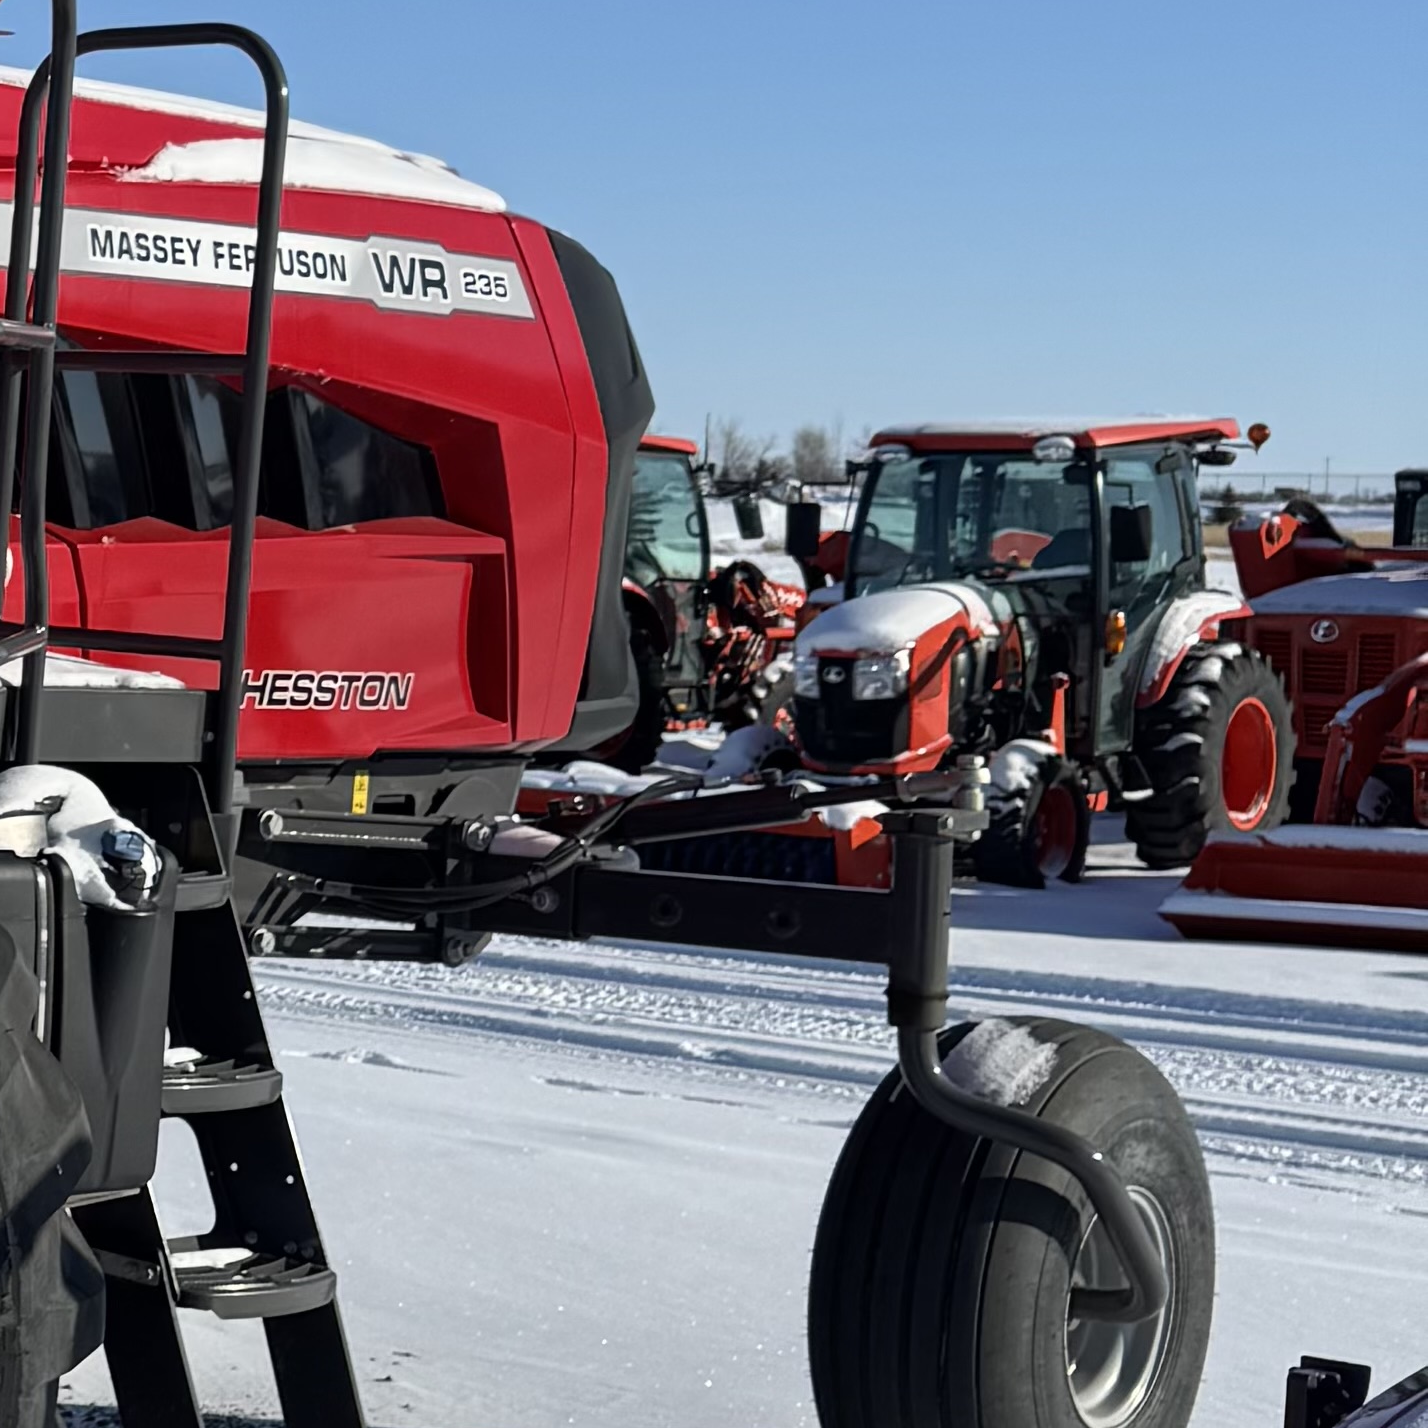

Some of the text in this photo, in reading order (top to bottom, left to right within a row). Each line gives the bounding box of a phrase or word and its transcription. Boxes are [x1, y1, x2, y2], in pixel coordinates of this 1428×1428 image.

[89, 228, 509, 300] MASSEY FERUSON WR 235
[240, 669, 415, 710] HESSTON
